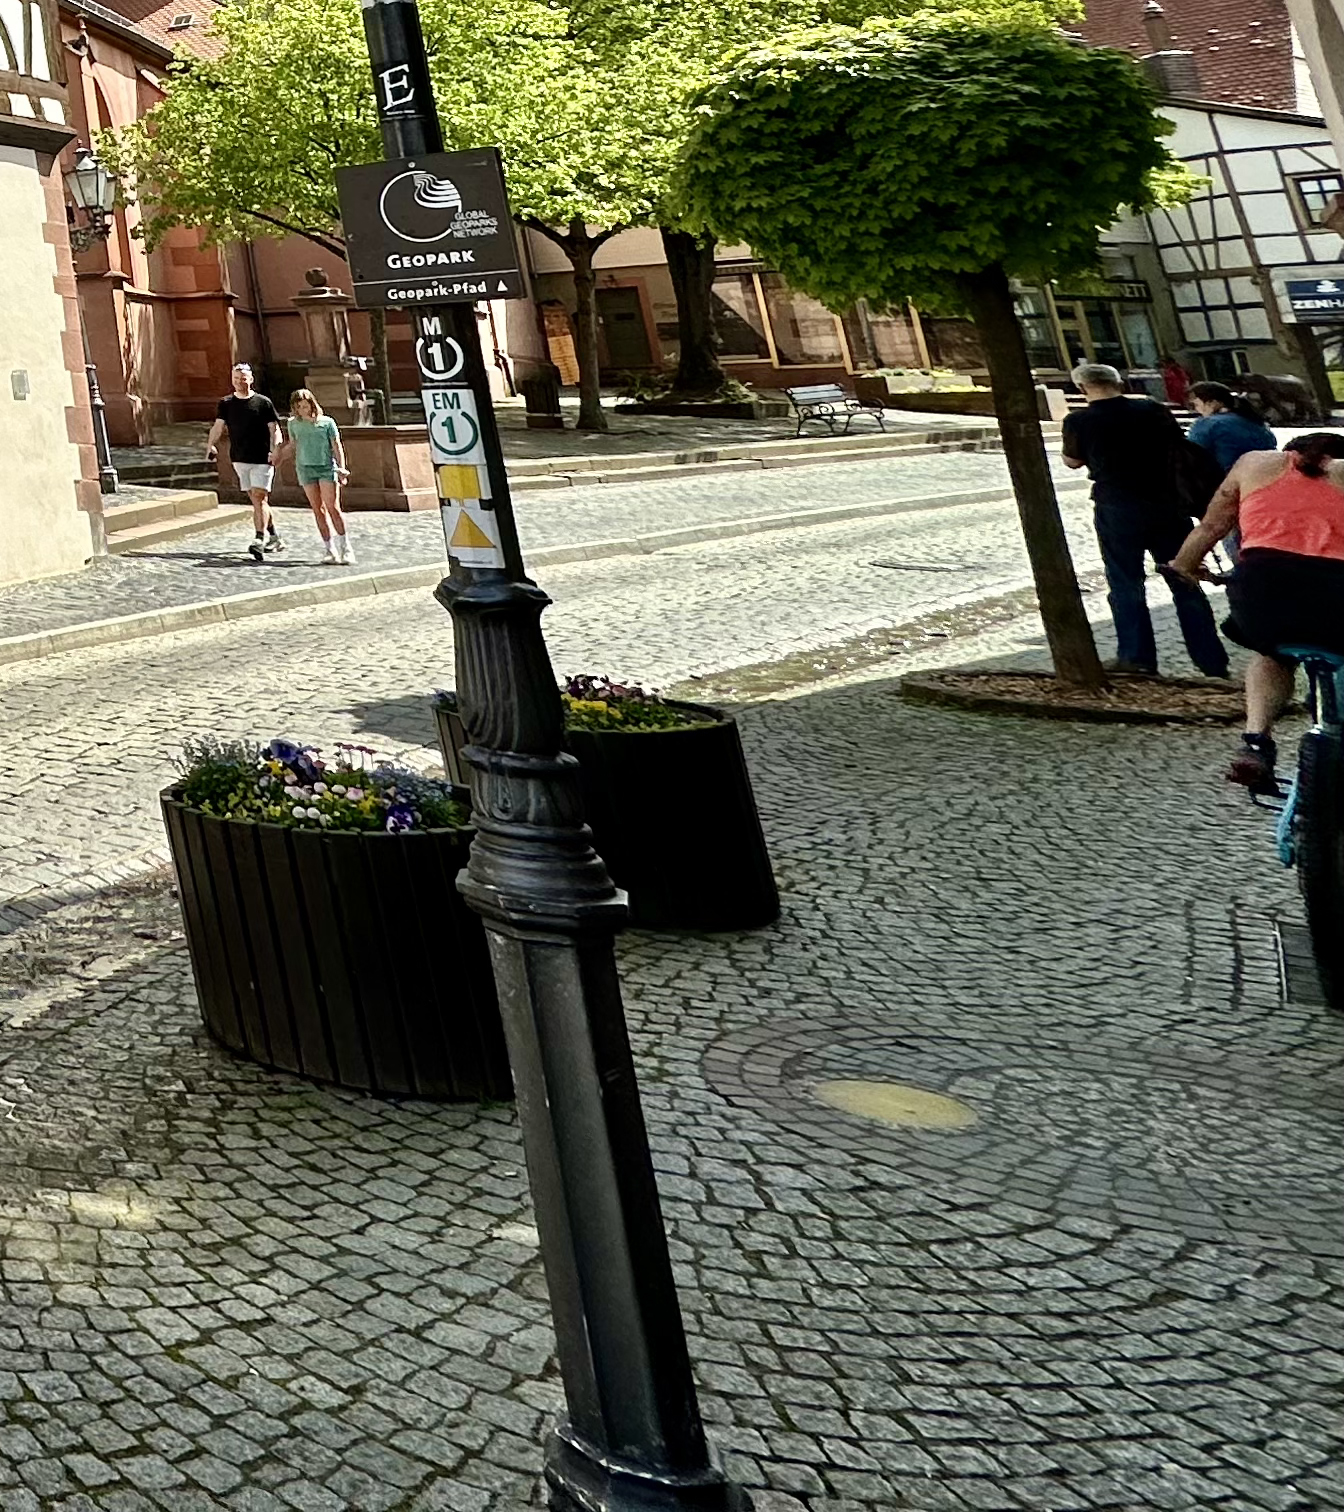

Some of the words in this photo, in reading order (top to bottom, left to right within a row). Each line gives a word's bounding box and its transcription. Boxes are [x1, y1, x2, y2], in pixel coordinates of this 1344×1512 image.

[378, 64, 415, 110] E
[450, 217, 499, 230] GEOPARKS
[454, 209, 490, 221] GLOBAL
[453, 226, 499, 239] NETWORK
[387, 280, 487, 301] Geopark-Pfad
[1291, 298, 1344, 309] ZENH
[422, 316, 442, 336] M
[427, 342, 445, 371] 1
[432, 392, 461, 410] EM
[441, 416, 457, 444] 1
